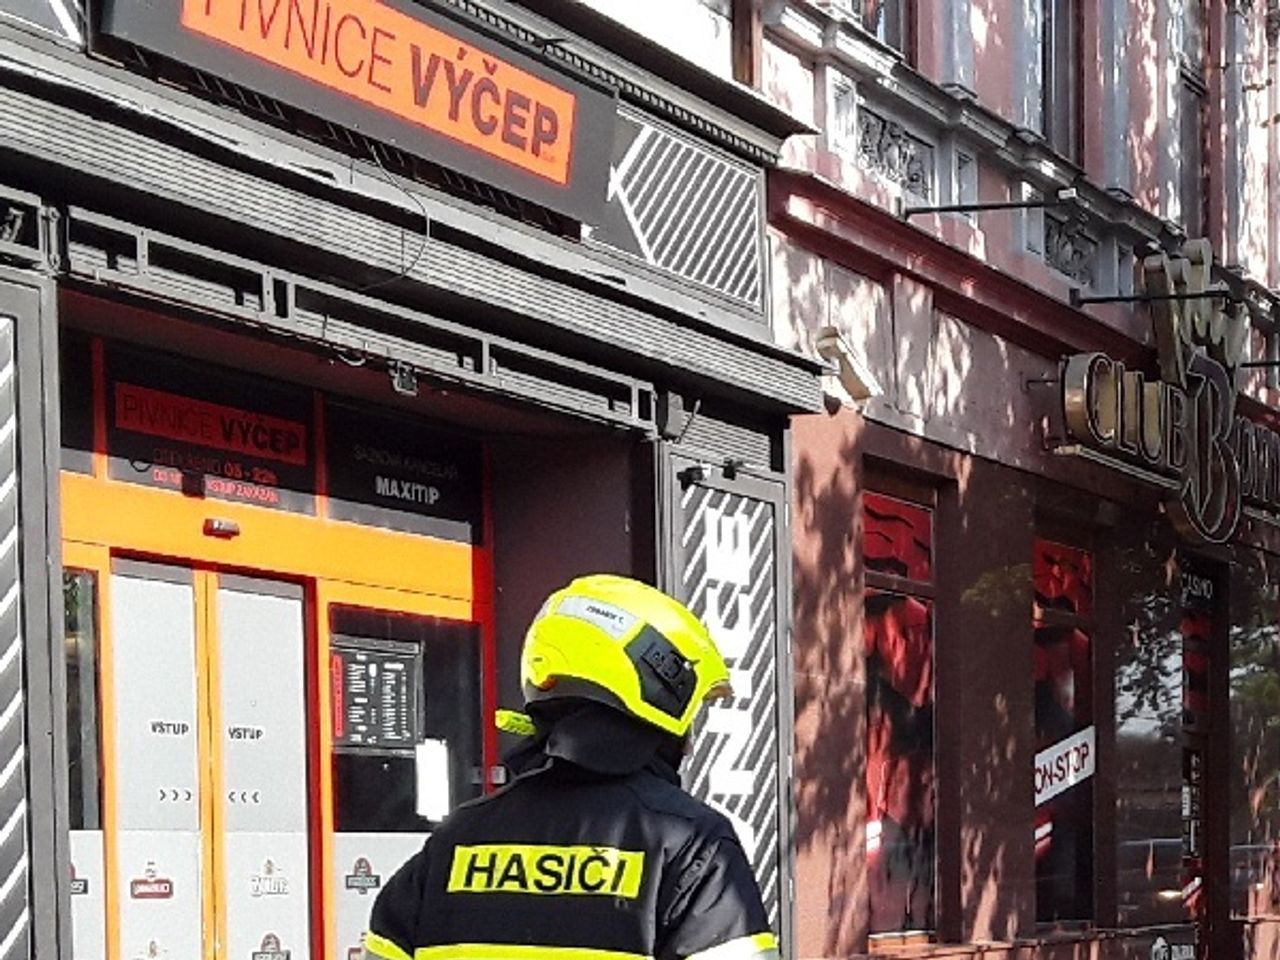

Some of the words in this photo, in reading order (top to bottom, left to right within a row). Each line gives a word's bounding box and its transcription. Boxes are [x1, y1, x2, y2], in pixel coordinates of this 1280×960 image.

[204, 0, 396, 94] IVNICE
[410, 43, 559, 158] VÝČEP
[374, 475, 440, 505] MAXITIP
[151, 721, 189, 735] VSTUP
[228, 727, 263, 740] VSTUP
[463, 848, 628, 892] HASIČI
